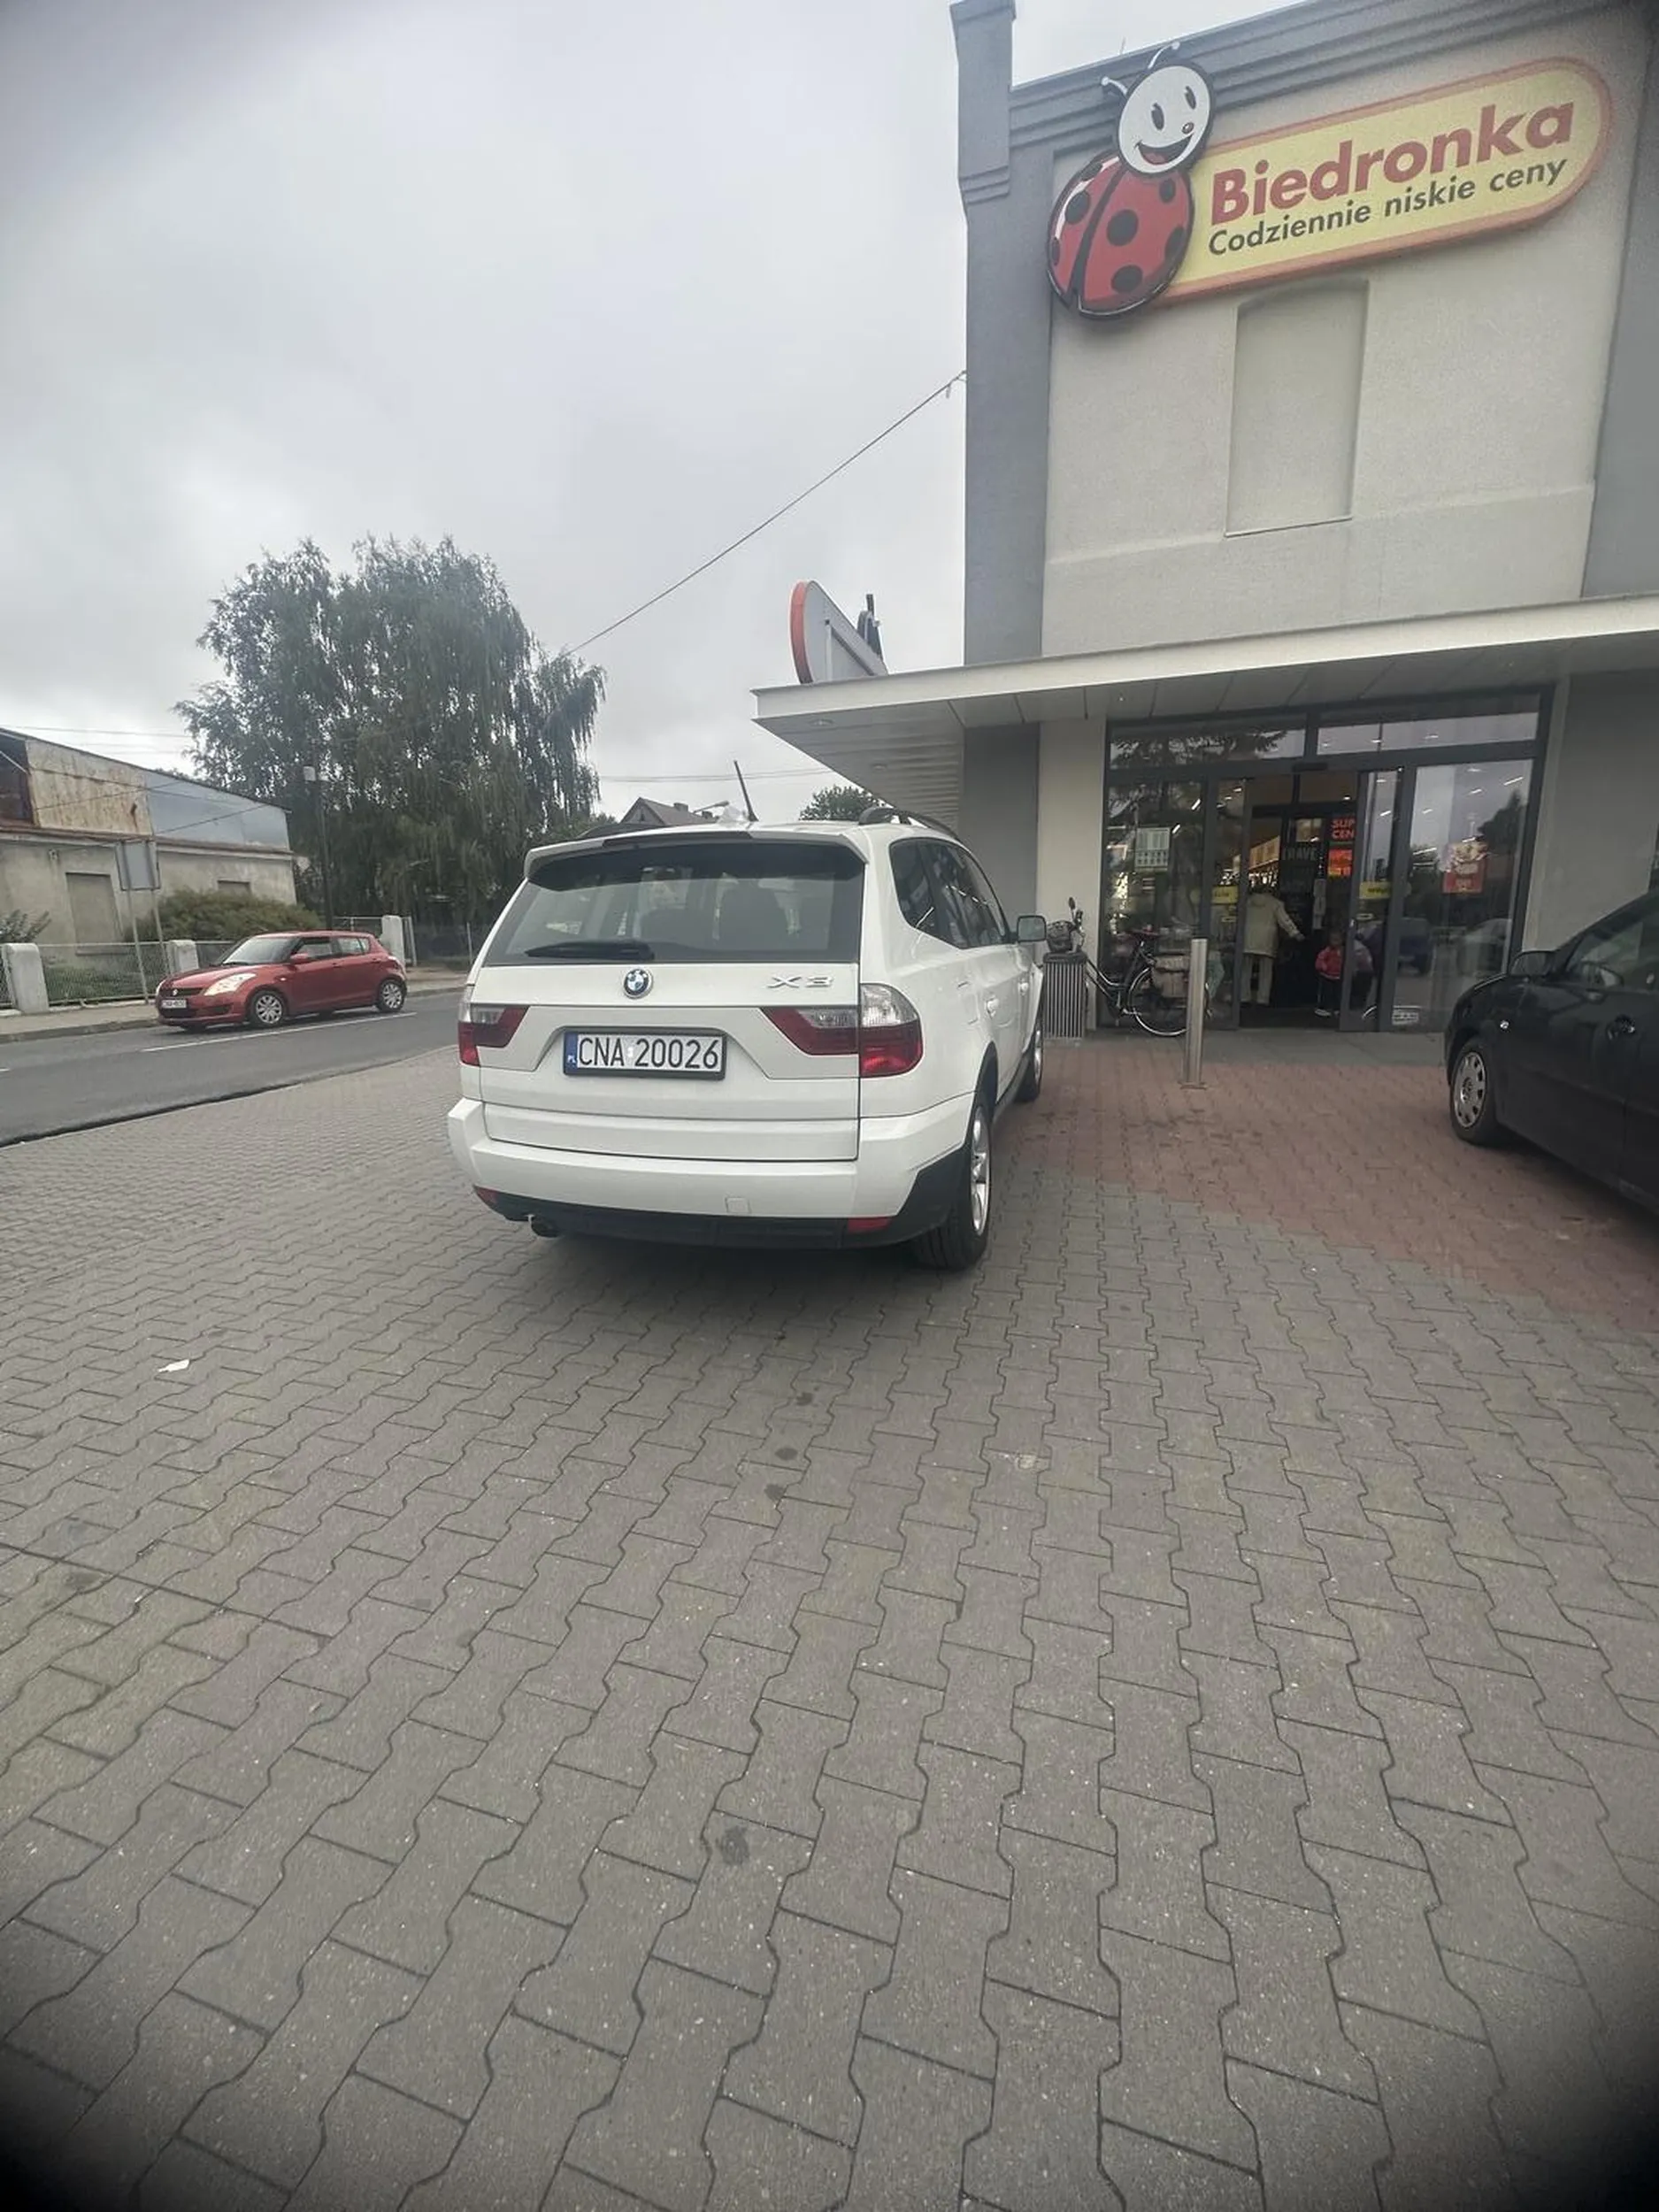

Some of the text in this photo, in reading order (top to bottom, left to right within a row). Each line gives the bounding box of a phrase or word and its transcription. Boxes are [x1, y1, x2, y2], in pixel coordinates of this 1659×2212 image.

[1211, 101, 1574, 226] Biedronka
[1209, 158, 1568, 256] Codziennie niskie ceny
[766, 975, 834, 989] X3
[579, 1037, 719, 1070] CNA 20026
